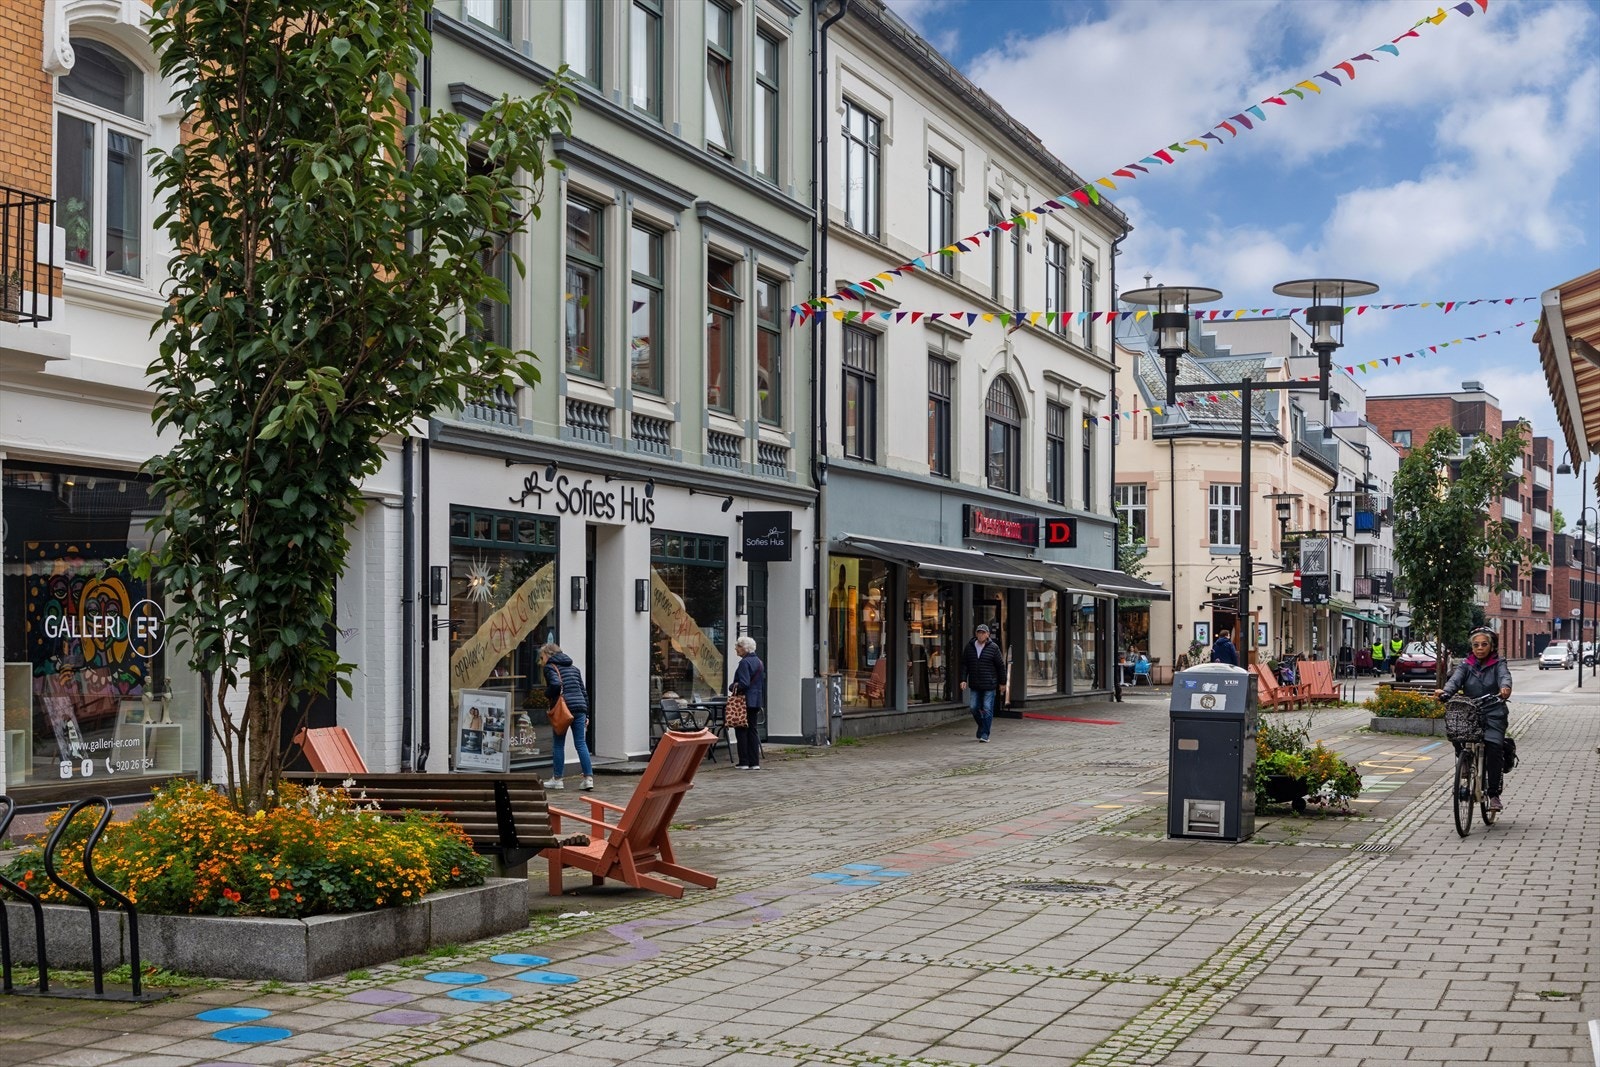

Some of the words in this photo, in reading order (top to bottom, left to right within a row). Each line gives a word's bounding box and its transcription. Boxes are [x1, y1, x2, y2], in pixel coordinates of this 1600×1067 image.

[555, 475, 616, 519] Sofies
[621, 485, 656, 524] Hus
[746, 537, 769, 546] Sofies
[769, 537, 785, 546] Hus
[44, 614, 120, 639] GALLERI
[136, 616, 159, 640] ER
[68, 737, 141, 753] www.galleri-er.com
[115, 760, 130, 771] 920
[130, 759, 141, 770] 26
